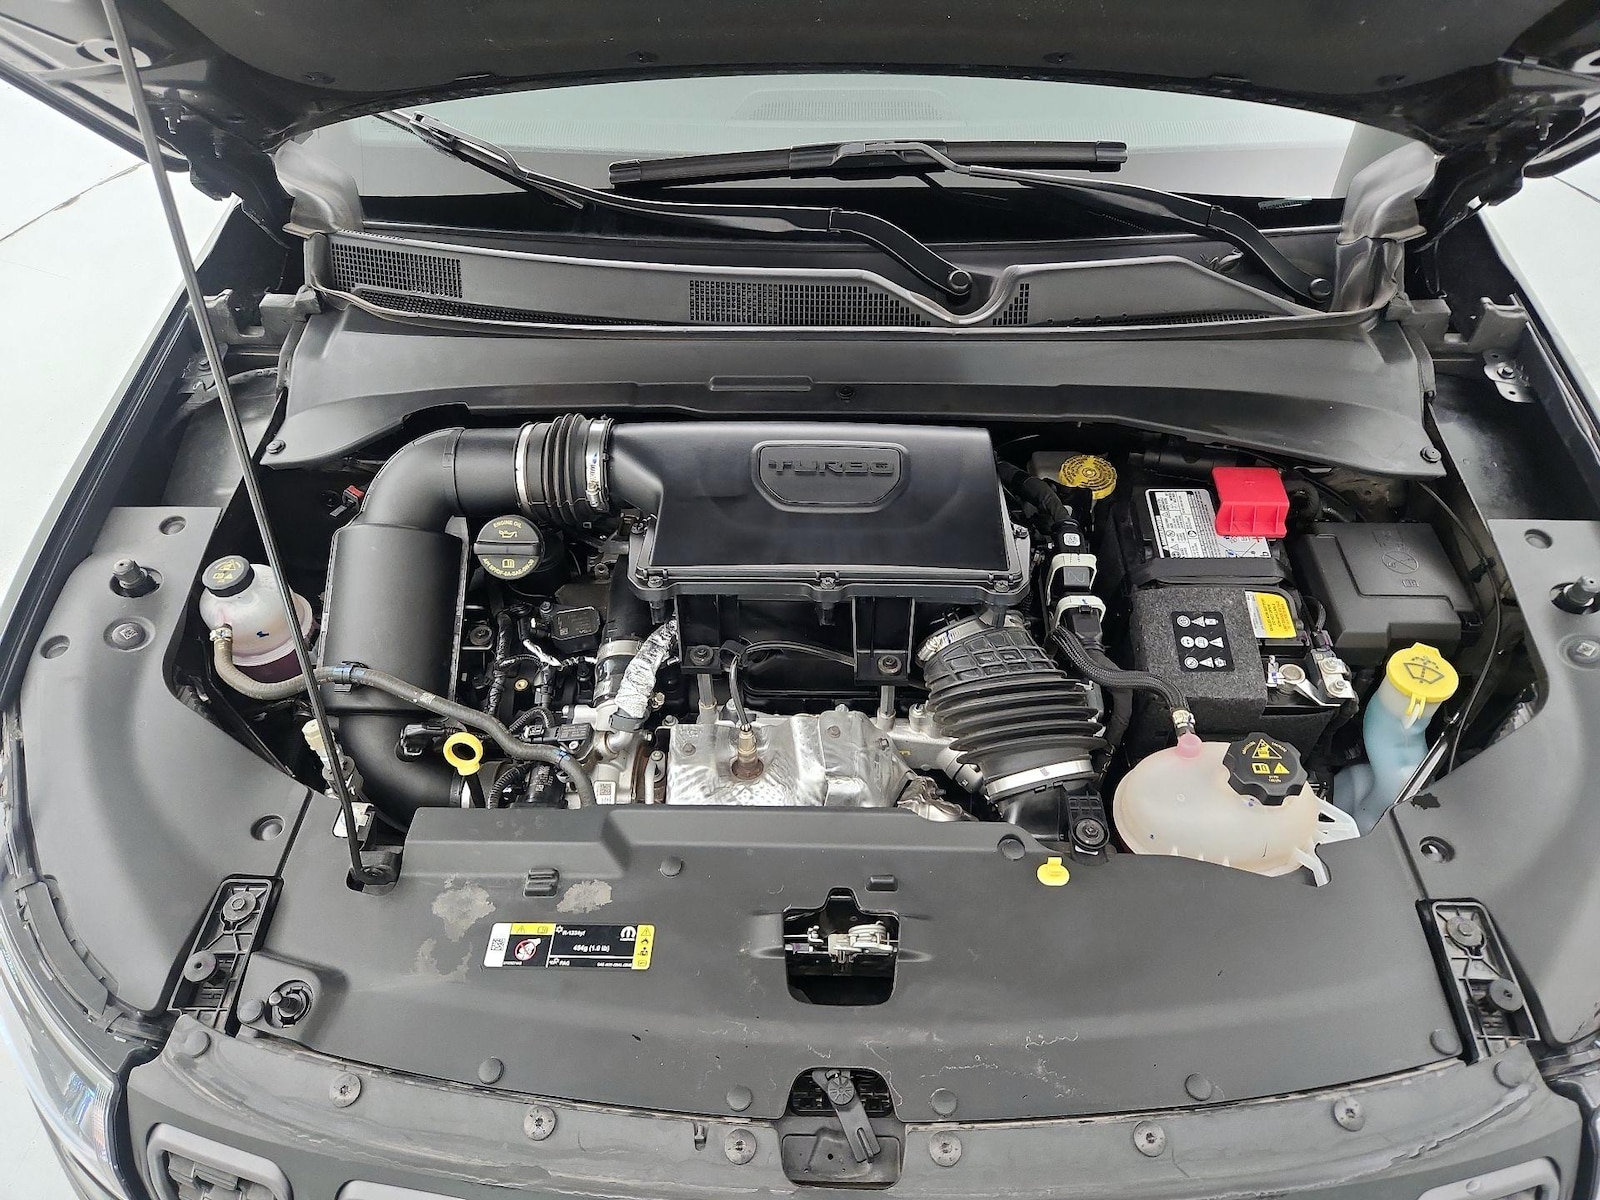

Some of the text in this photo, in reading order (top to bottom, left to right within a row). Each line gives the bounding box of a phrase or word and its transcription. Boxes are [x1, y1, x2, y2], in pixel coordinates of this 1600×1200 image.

[768, 460, 895, 476] TURBO
[494, 520, 522, 529] ENGINE OIL
